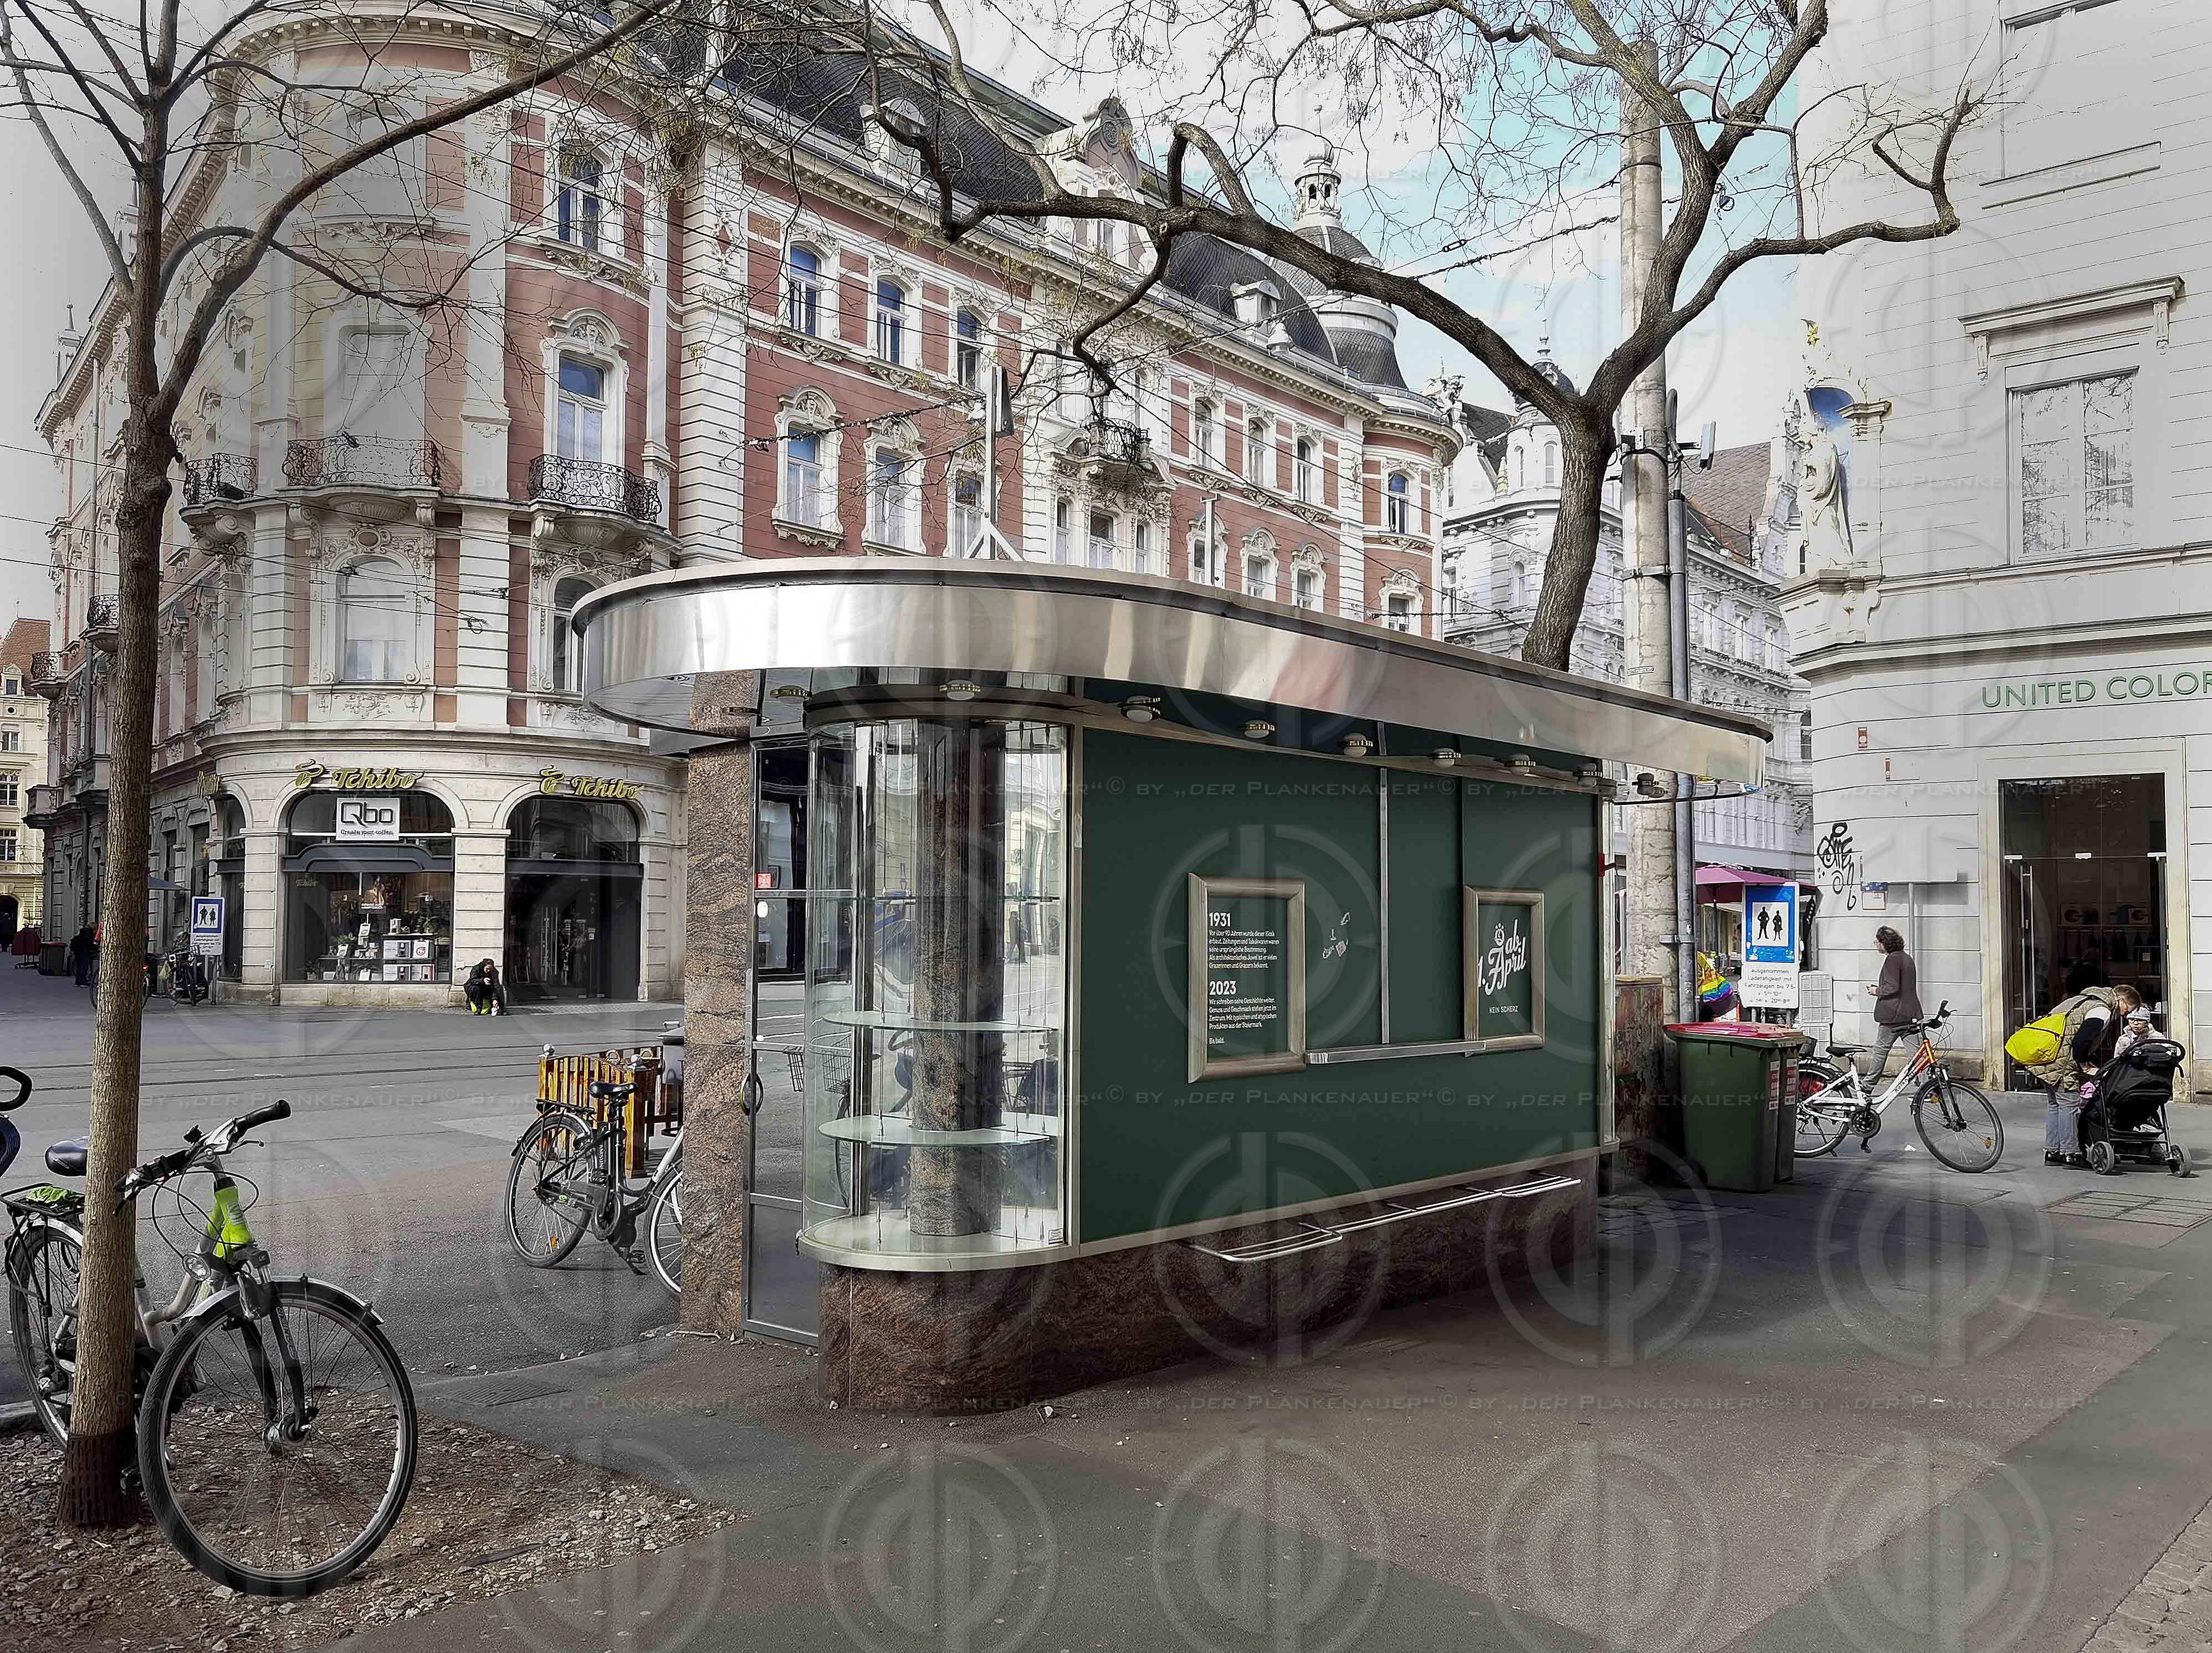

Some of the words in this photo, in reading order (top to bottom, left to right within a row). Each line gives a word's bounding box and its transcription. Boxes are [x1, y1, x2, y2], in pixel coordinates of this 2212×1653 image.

[1981, 680, 2096, 708] UNITED
[332, 768, 425, 789] Tchibo
[570, 776, 645, 798] Tchibo
[341, 802, 395, 828] Qbo
[1209, 912, 1231, 927] 1931
[1505, 918, 1521, 955] ab
[1485, 936, 1527, 996] April
[1209, 980, 1237, 995] 2023
[1489, 1005, 1500, 1014] KEIN
[1500, 1004, 1518, 1013] SCHERZ
